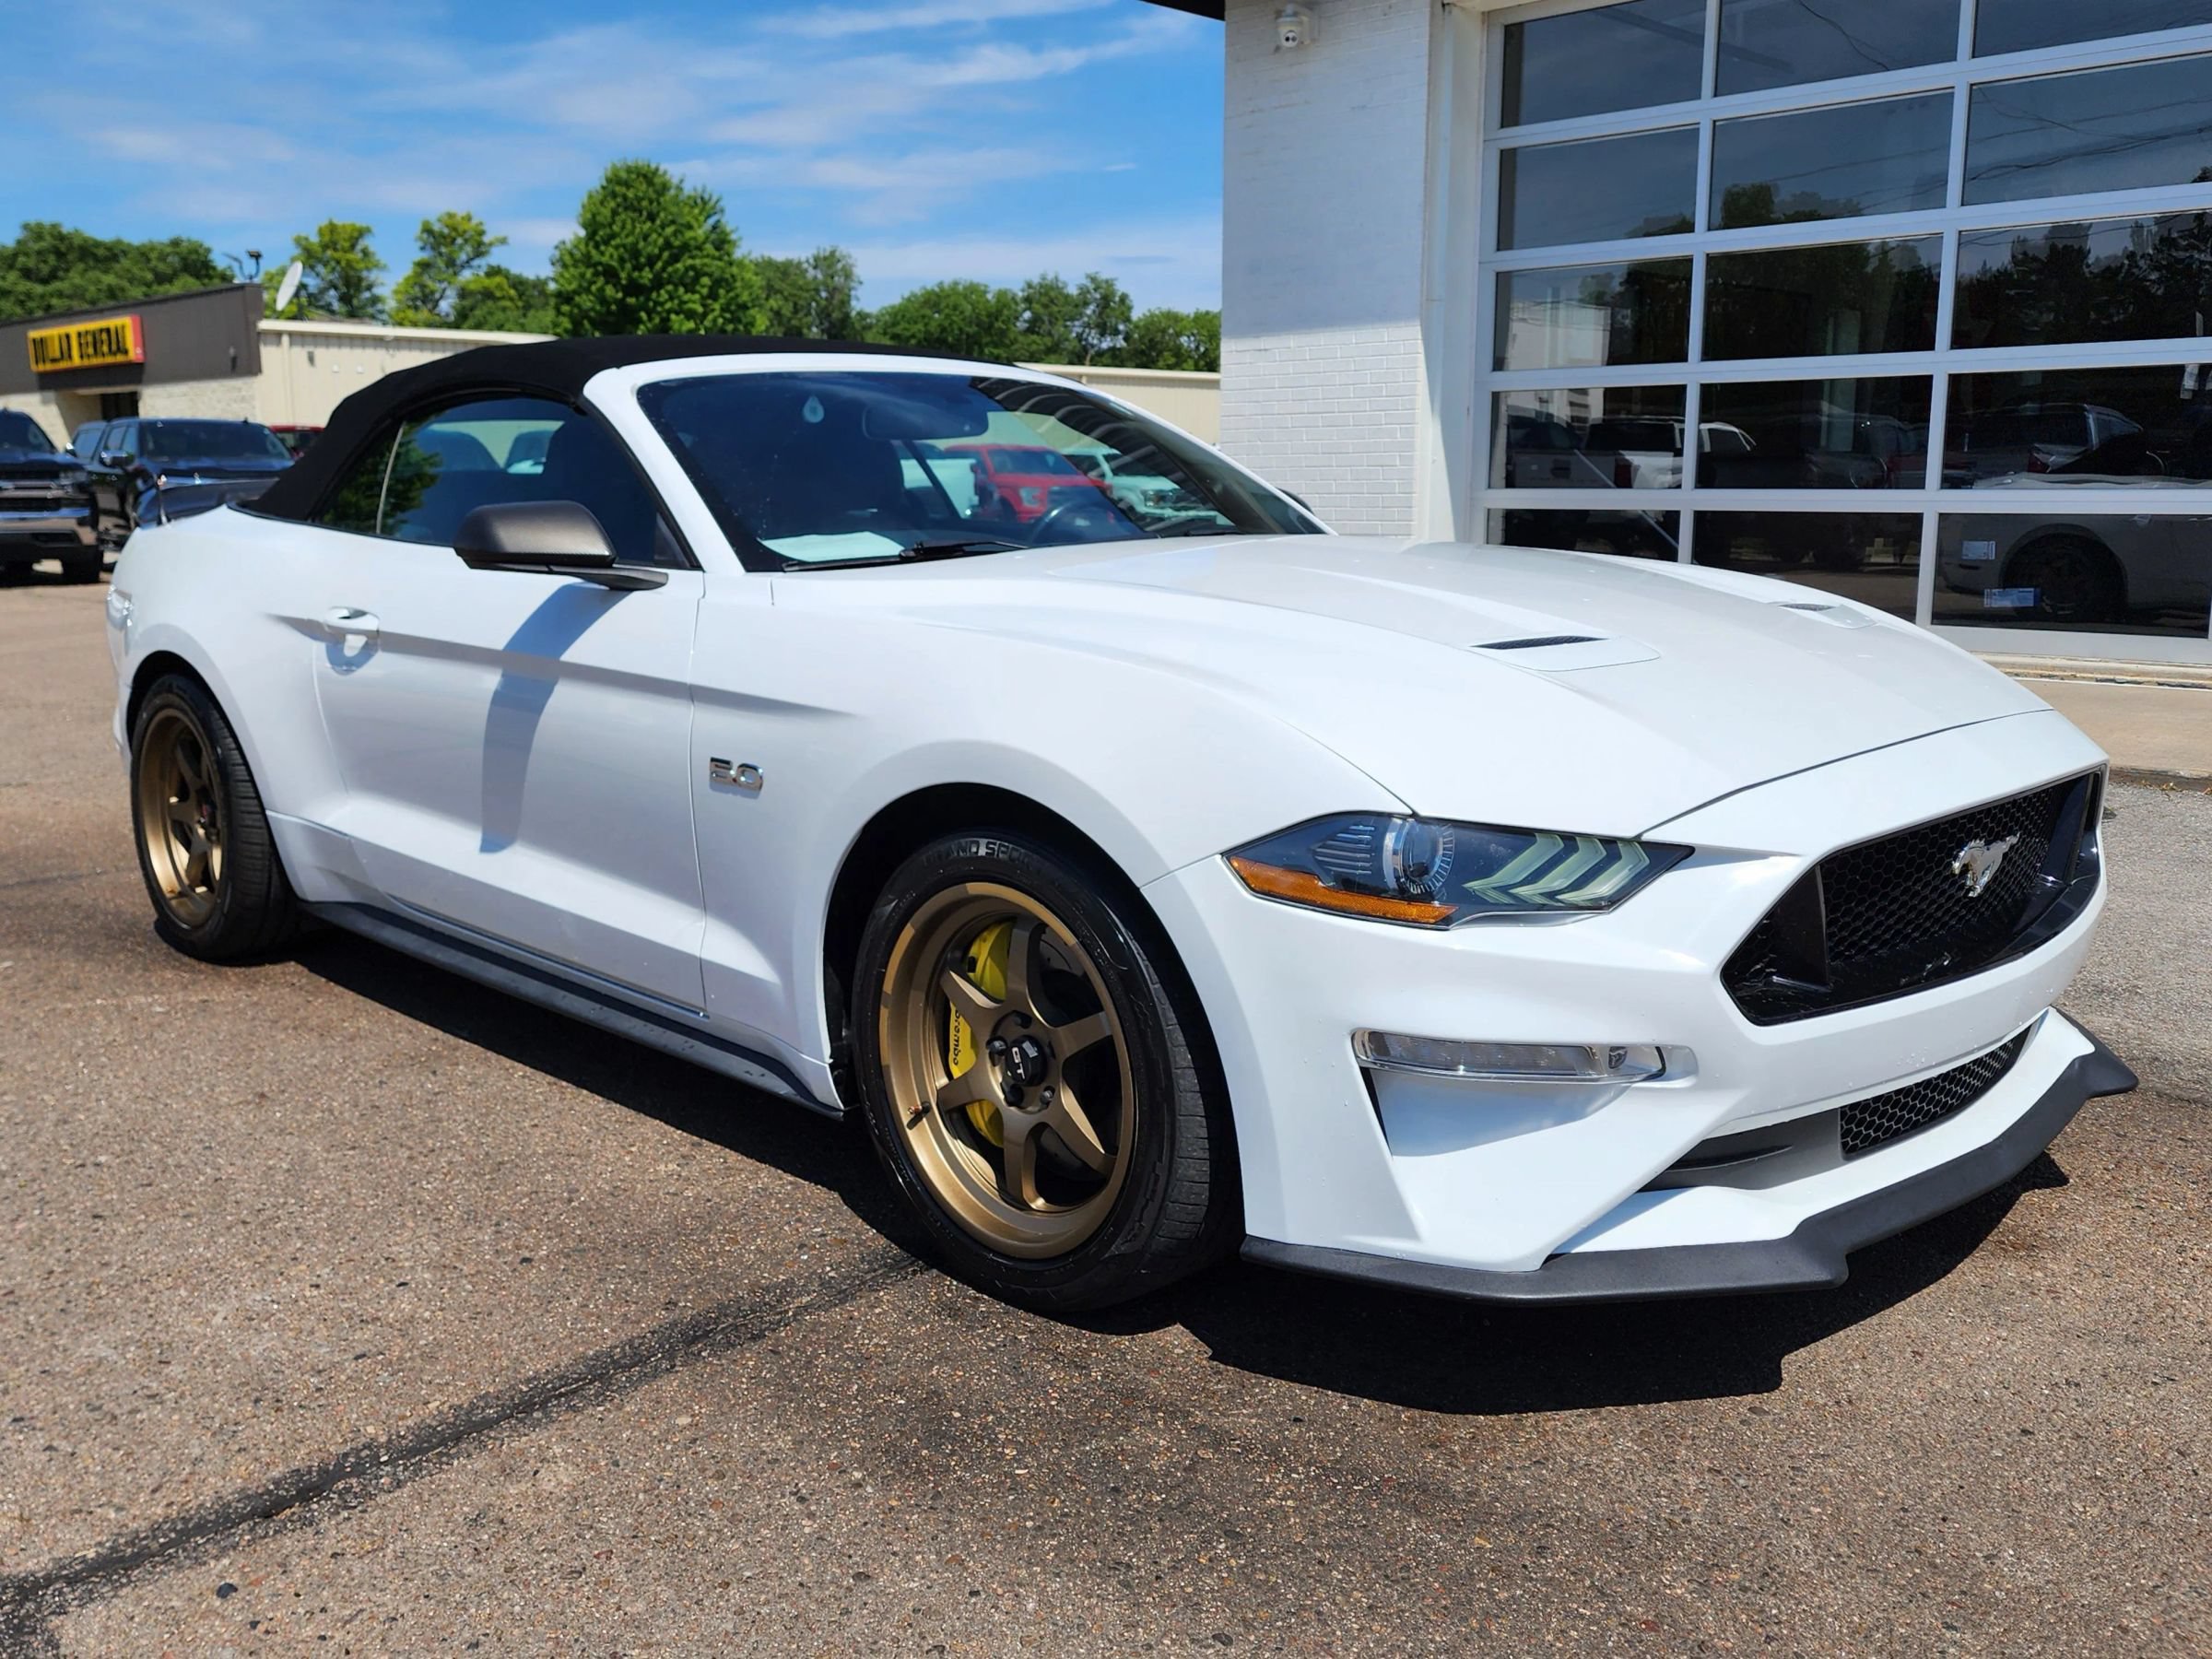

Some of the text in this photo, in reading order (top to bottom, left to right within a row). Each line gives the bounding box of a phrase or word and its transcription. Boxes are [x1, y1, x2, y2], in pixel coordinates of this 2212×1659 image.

[709, 756, 764, 791] 5.0
[984, 841, 1039, 875] SPOR
[1012, 1046, 1026, 1079] GT
